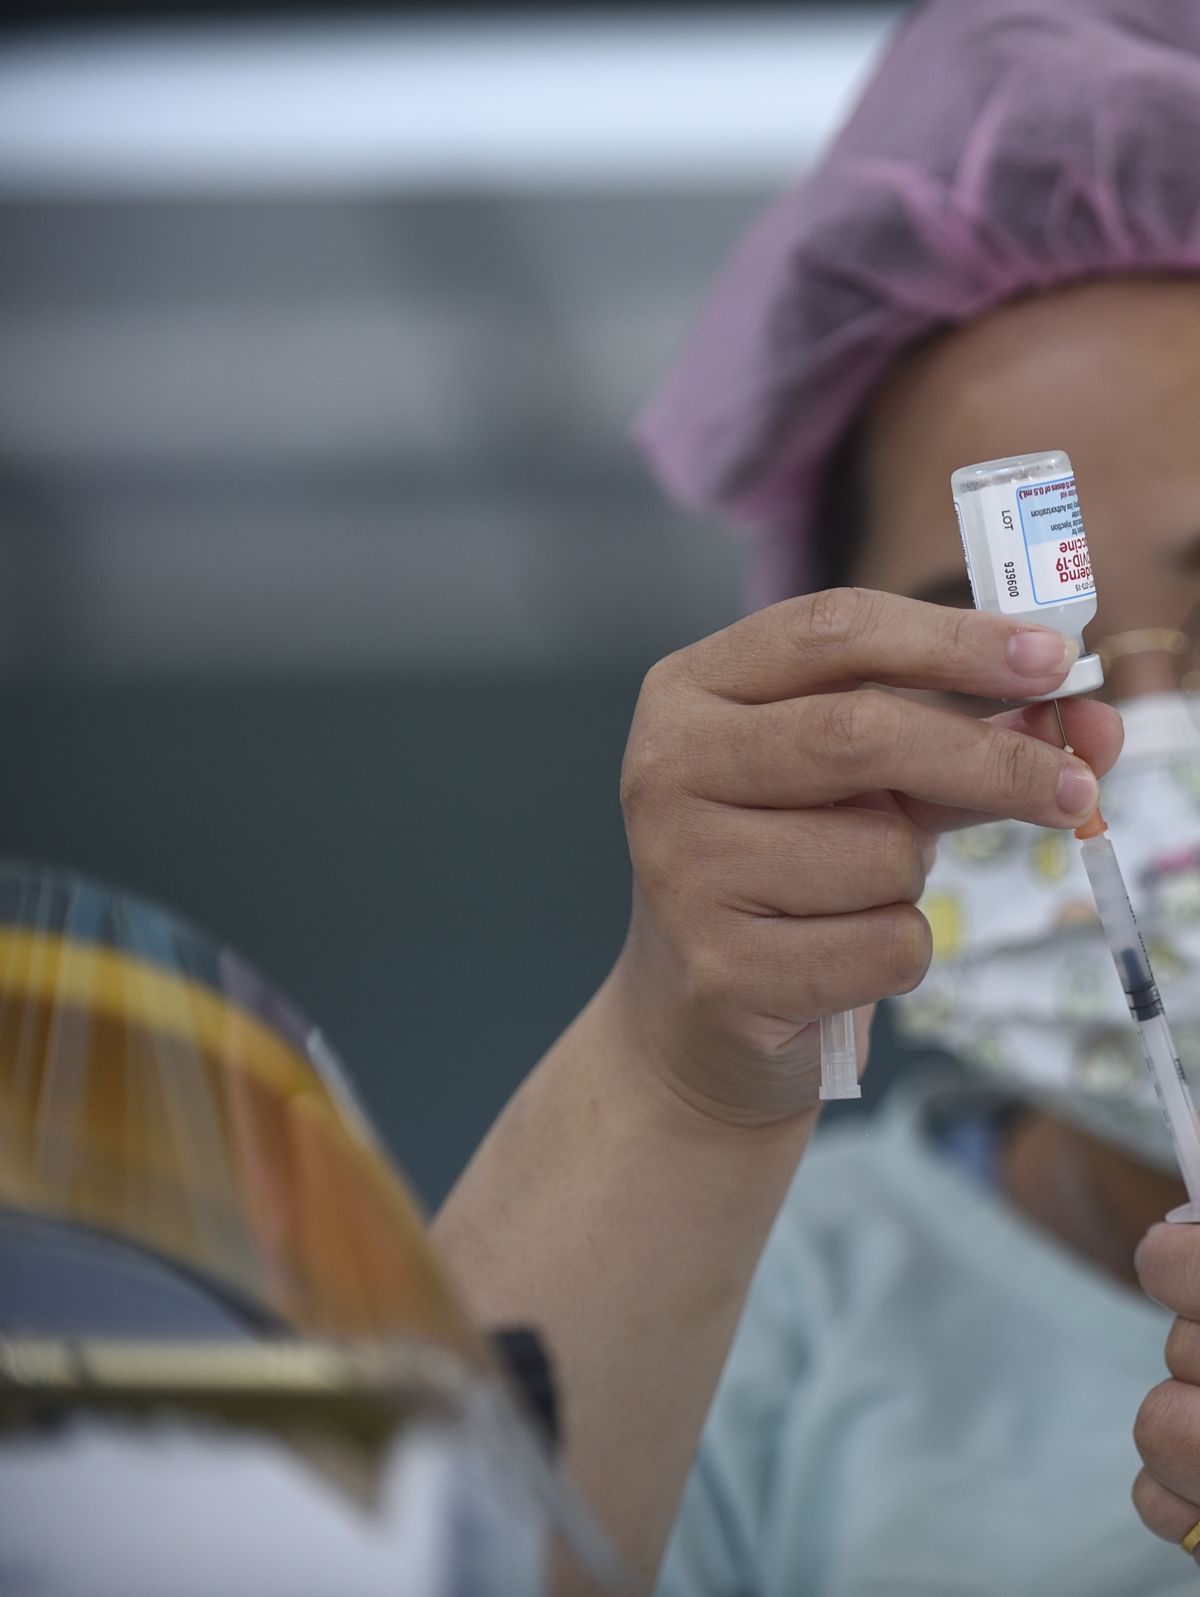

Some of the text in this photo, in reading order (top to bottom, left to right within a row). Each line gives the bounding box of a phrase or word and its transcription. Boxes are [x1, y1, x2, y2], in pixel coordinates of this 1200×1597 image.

[1033, 486, 1045, 496] 0.5
[1031, 504, 1067, 517] Authorization
[1001, 509, 1014, 531] LOT
[1059, 537, 1087, 553] ccine
[1004, 561, 1019, 598] 939600
